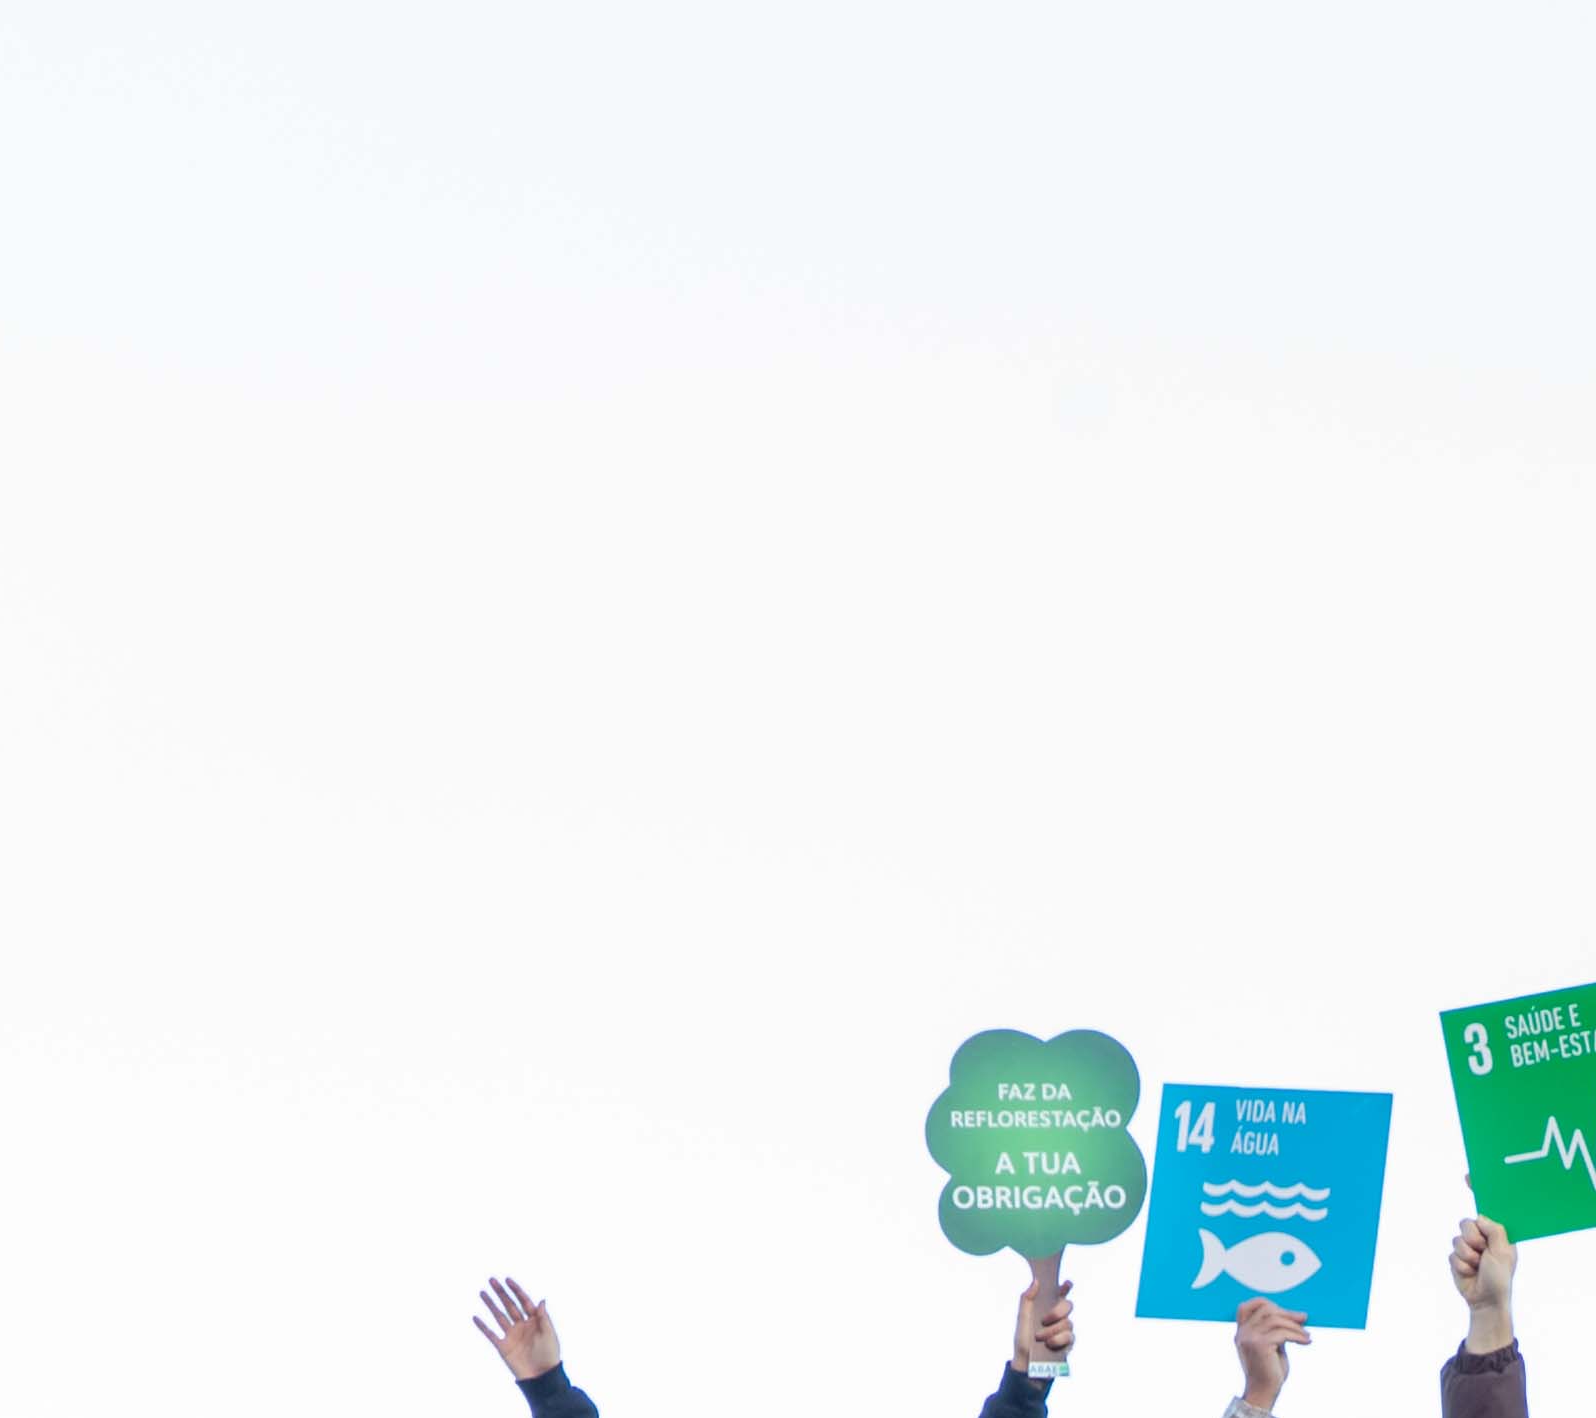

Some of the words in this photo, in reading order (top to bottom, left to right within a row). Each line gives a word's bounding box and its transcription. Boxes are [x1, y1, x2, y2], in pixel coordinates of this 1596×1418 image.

[1504, 1004, 1566, 1039] SAÚDE
[1568, 1003, 1582, 1027] E
[1463, 1022, 1493, 1076] 3
[997, 1083, 1036, 1101] FAZ
[1042, 1083, 1072, 1101] DA
[950, 1106, 1122, 1132] REFLORESTAÇÃO
[1174, 1100, 1216, 1153] 14
[1235, 1099, 1276, 1124] VIDA
[1281, 1101, 1307, 1125] NA
[1230, 1127, 1280, 1156] ÁGUA
[995, 1151, 1016, 1175] A
[1022, 1151, 1081, 1175] TUA
[952, 1182, 1127, 1215] OBRIGAÇÃO
